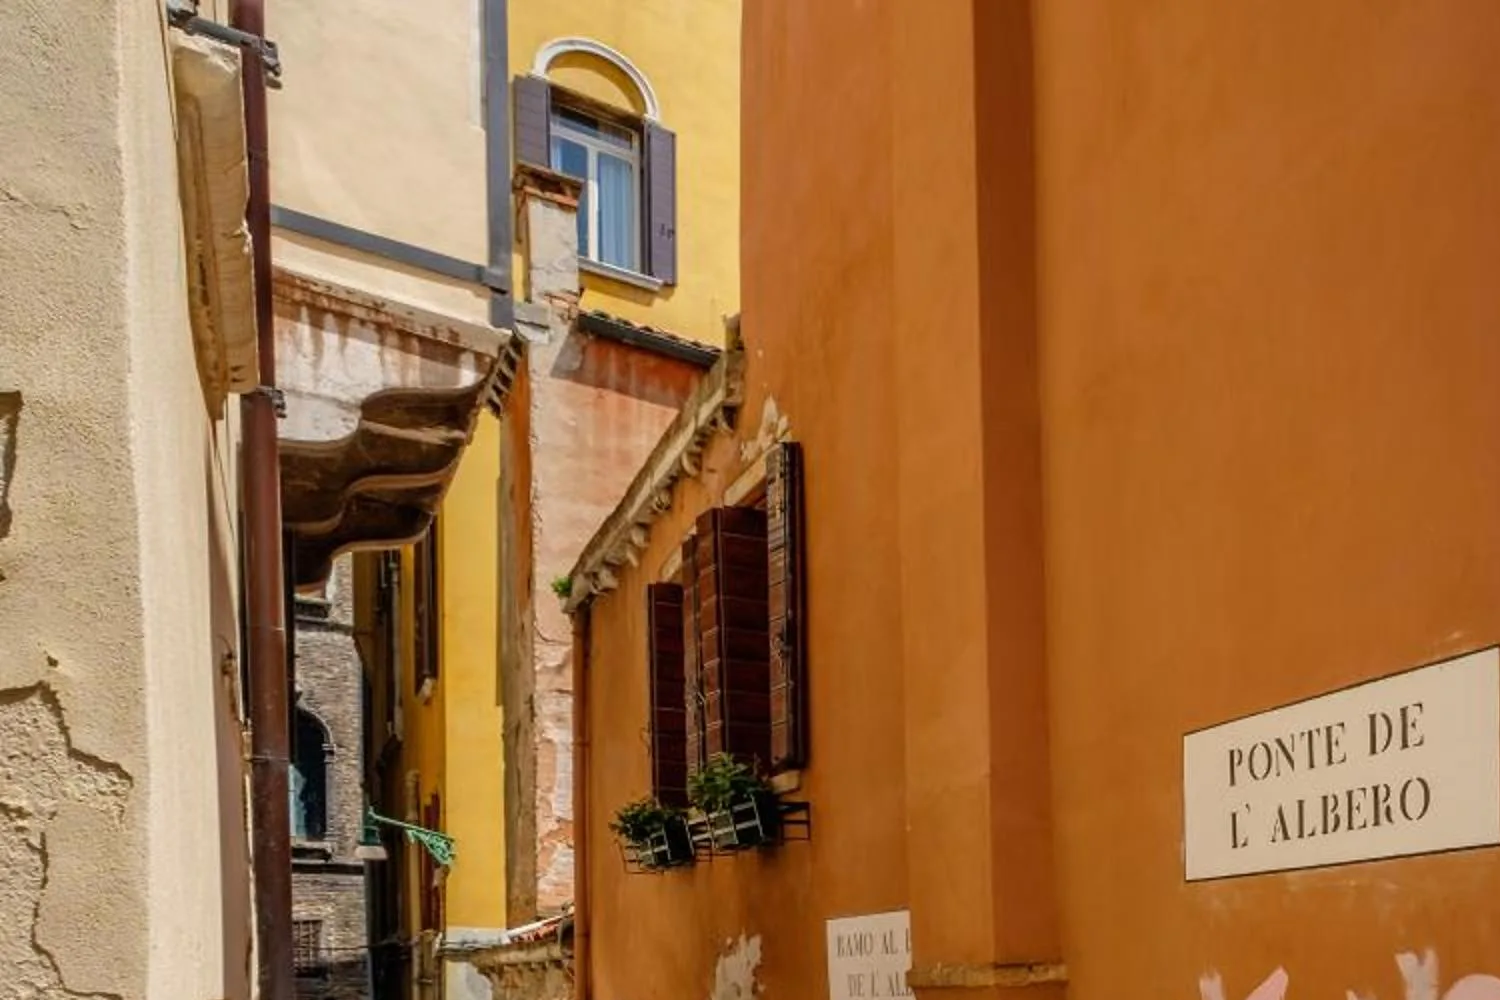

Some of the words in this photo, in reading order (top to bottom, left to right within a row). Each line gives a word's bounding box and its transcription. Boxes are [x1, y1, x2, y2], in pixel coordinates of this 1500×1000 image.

[1227, 721, 1347, 787] PONTE
[1368, 702, 1425, 756] DE
[1269, 776, 1432, 844] ALBERO
[836, 931, 874, 957] RAMO
[881, 930, 898, 955] AL
[848, 973, 865, 998] DE
